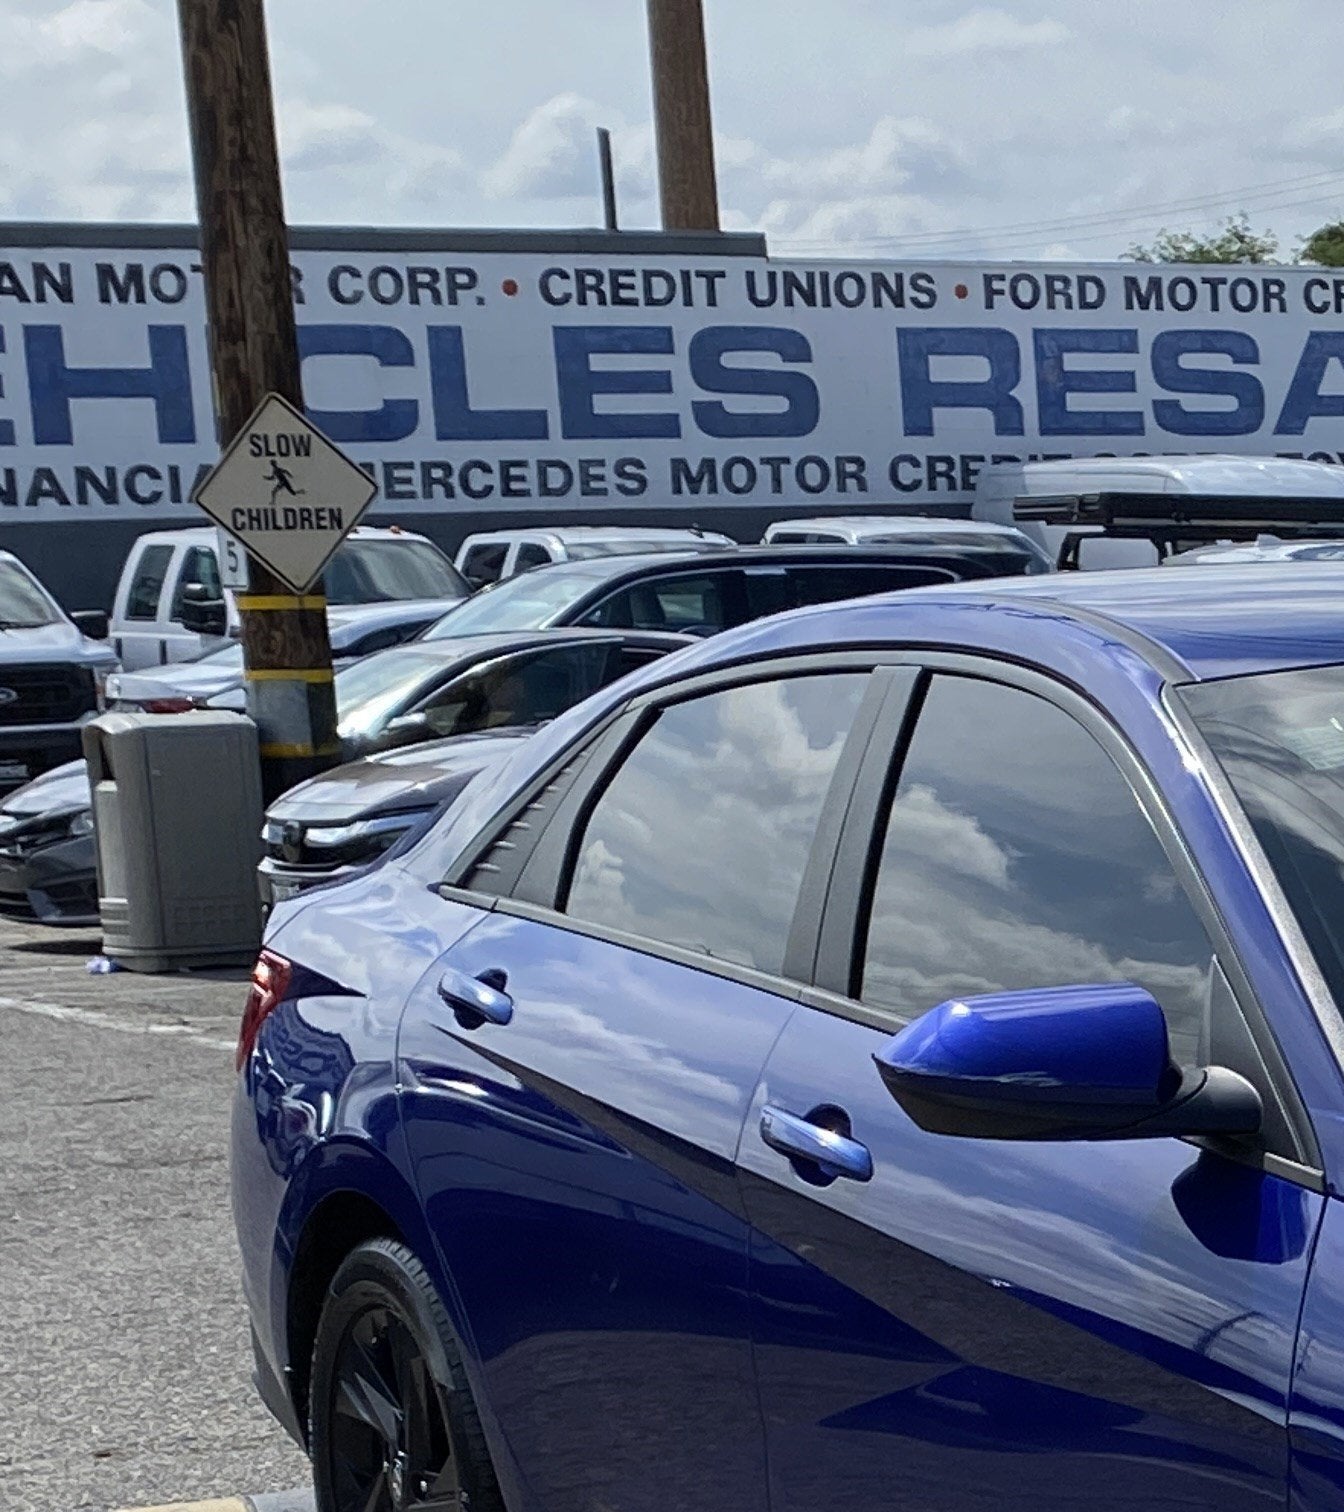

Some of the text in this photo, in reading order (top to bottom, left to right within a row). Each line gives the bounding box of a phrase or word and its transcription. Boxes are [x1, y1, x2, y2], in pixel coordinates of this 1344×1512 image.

[328, 264, 485, 305] CORP.
[537, 267, 725, 307] CREDIT
[744, 271, 937, 308] UNIONS
[983, 272, 1104, 311] FORD
[1125, 276, 1287, 313] MOTOR
[0, 324, 820, 445] HCLES
[249, 432, 312, 458] SLOW
[357, 458, 647, 500] ERCEDES
[671, 457, 867, 495] MOTOR
[231, 506, 343, 532] CHILDREN
[225, 540, 239, 574] 5
